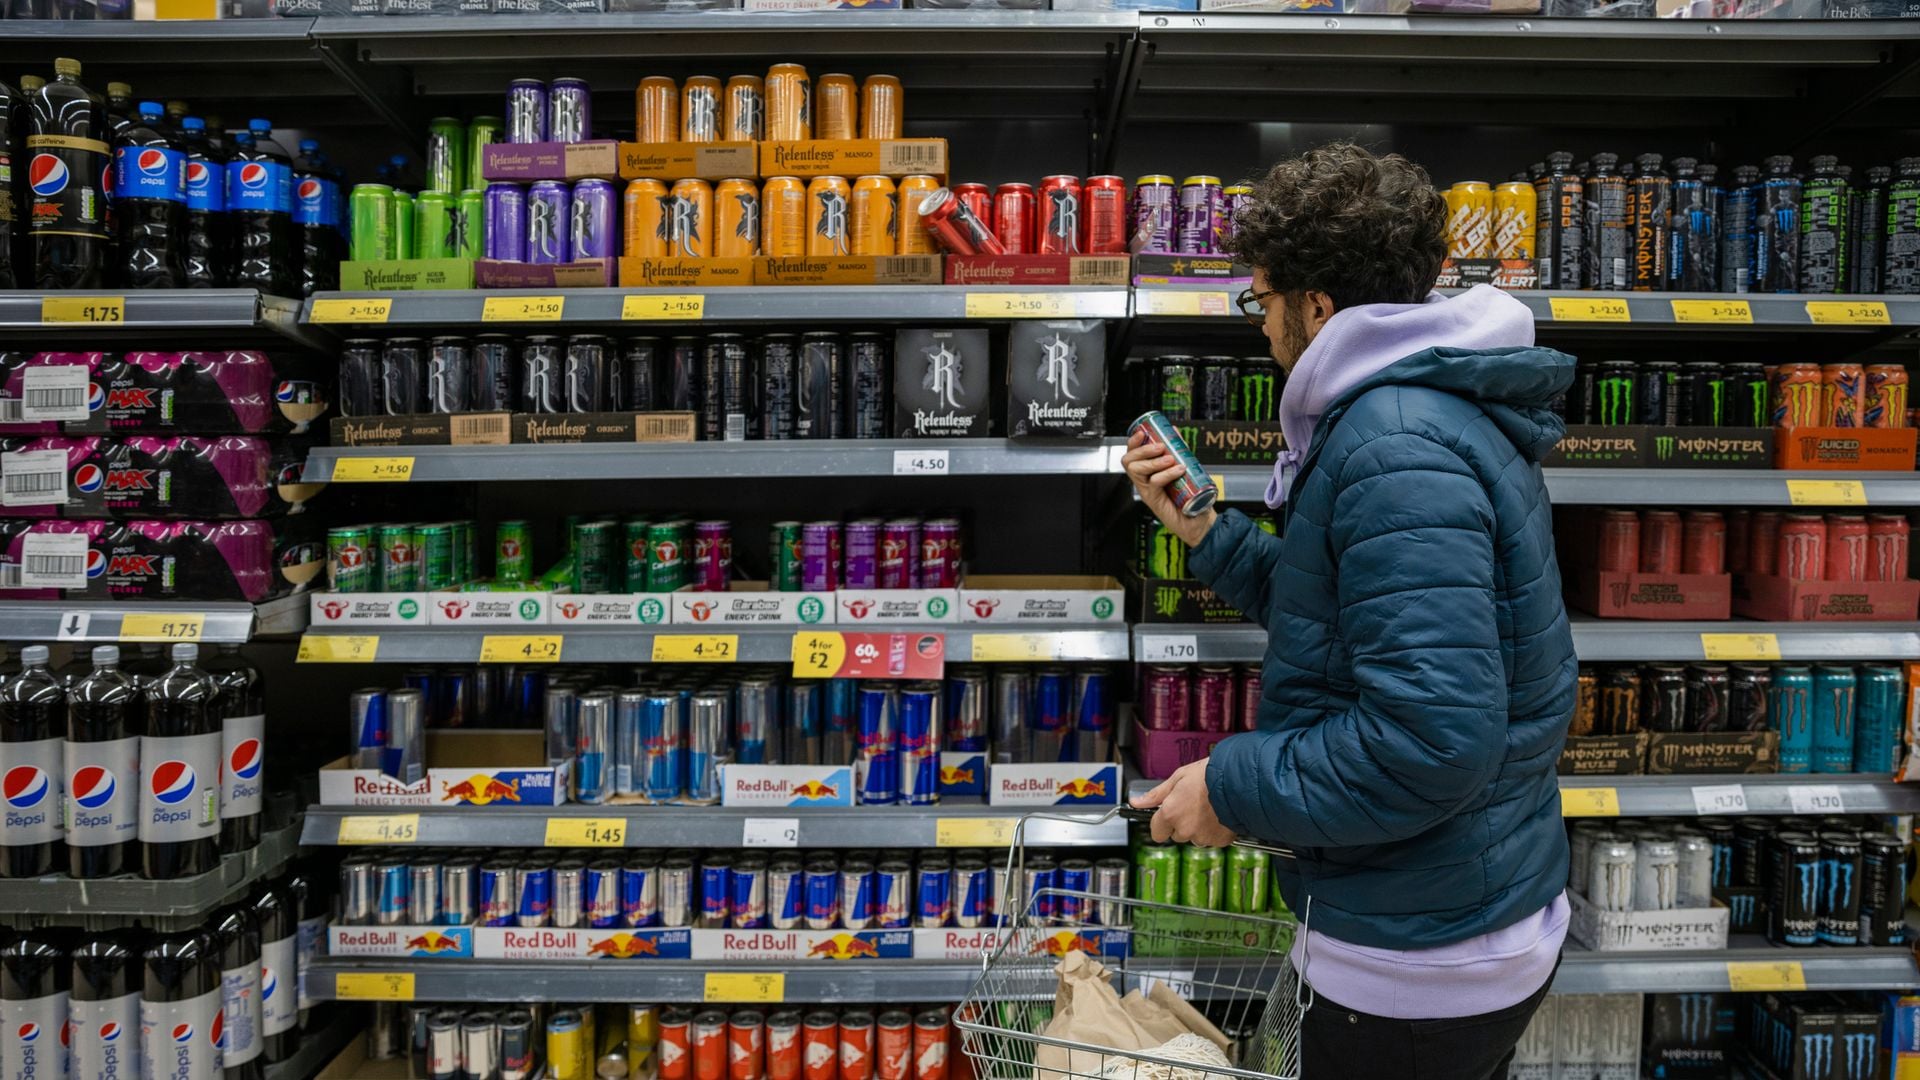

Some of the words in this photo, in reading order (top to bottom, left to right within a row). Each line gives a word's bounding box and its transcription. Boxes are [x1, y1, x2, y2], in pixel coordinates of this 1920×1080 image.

[774, 144, 835, 168] Relentless
[140, 177, 166, 186] pepsi
[1635, 191, 1653, 279] MONSTER
[641, 260, 701, 285] Relentless
[766, 257, 828, 281] Relentless
[954, 259, 1014, 284] Relentless
[363, 268, 417, 290] Relentless
[1491, 276, 1537, 288] ALERT
[350, 307, 356, 315] 2
[363, 307, 386, 315] £1.50
[536, 304, 559, 313] £1.50
[676, 302, 699, 311] £1.50
[1006, 301, 1011, 309] 2
[83, 307, 119, 322] £1.75
[110, 379, 133, 388] pepsi
[105, 388, 158, 409] MAX
[1027, 400, 1087, 427] Relentless
[914, 408, 973, 435] Relentless
[342, 422, 402, 446] Relentless
[526, 418, 586, 443] Relentless
[1205, 428, 1284, 450] MONST
[1678, 437, 1765, 453] MONSTER
[1818, 439, 1860, 449] JUICED
[1225, 452, 1272, 460] ENER
[109, 461, 131, 469] pepsi
[912, 459, 945, 470] £4.50
[103, 469, 156, 490] MAX
[112, 546, 135, 554] pepsi
[106, 555, 160, 575] MAX
[732, 599, 780, 610] Carabao
[724, 613, 756, 621] ENERGY
[758, 613, 782, 621] DRINK
[162, 623, 198, 638] £1.75
[522, 643, 532, 656] 4
[544, 642, 557, 656] £2
[694, 643, 703, 655] 4
[716, 642, 729, 656] £2
[809, 638, 817, 649] 4
[855, 643, 880, 658] 60p
[1165, 644, 1195, 657] £1.70
[809, 652, 829, 669] £2
[1563, 748, 1631, 760] MONSTER
[1682, 743, 1754, 756] MONSTER
[1574, 760, 1617, 769] MULE
[736, 780, 761, 791] Red
[763, 779, 787, 791] Bull
[1002, 779, 1027, 790] Red
[1029, 778, 1053, 790] Bull
[6, 812, 45, 828] pepsi
[75, 812, 112, 828] pepsi
[153, 808, 191, 824] pepsi
[378, 825, 413, 839] £1.45
[585, 828, 621, 843] £1.45
[784, 828, 796, 841] £2
[1637, 923, 1714, 935] MONSTER
[340, 932, 367, 945] Red
[369, 932, 396, 945] Bull
[505, 931, 539, 948] Red
[543, 932, 576, 948] Bull
[724, 933, 758, 950] Red
[763, 933, 796, 950] Bull
[946, 931, 981, 948] Red
